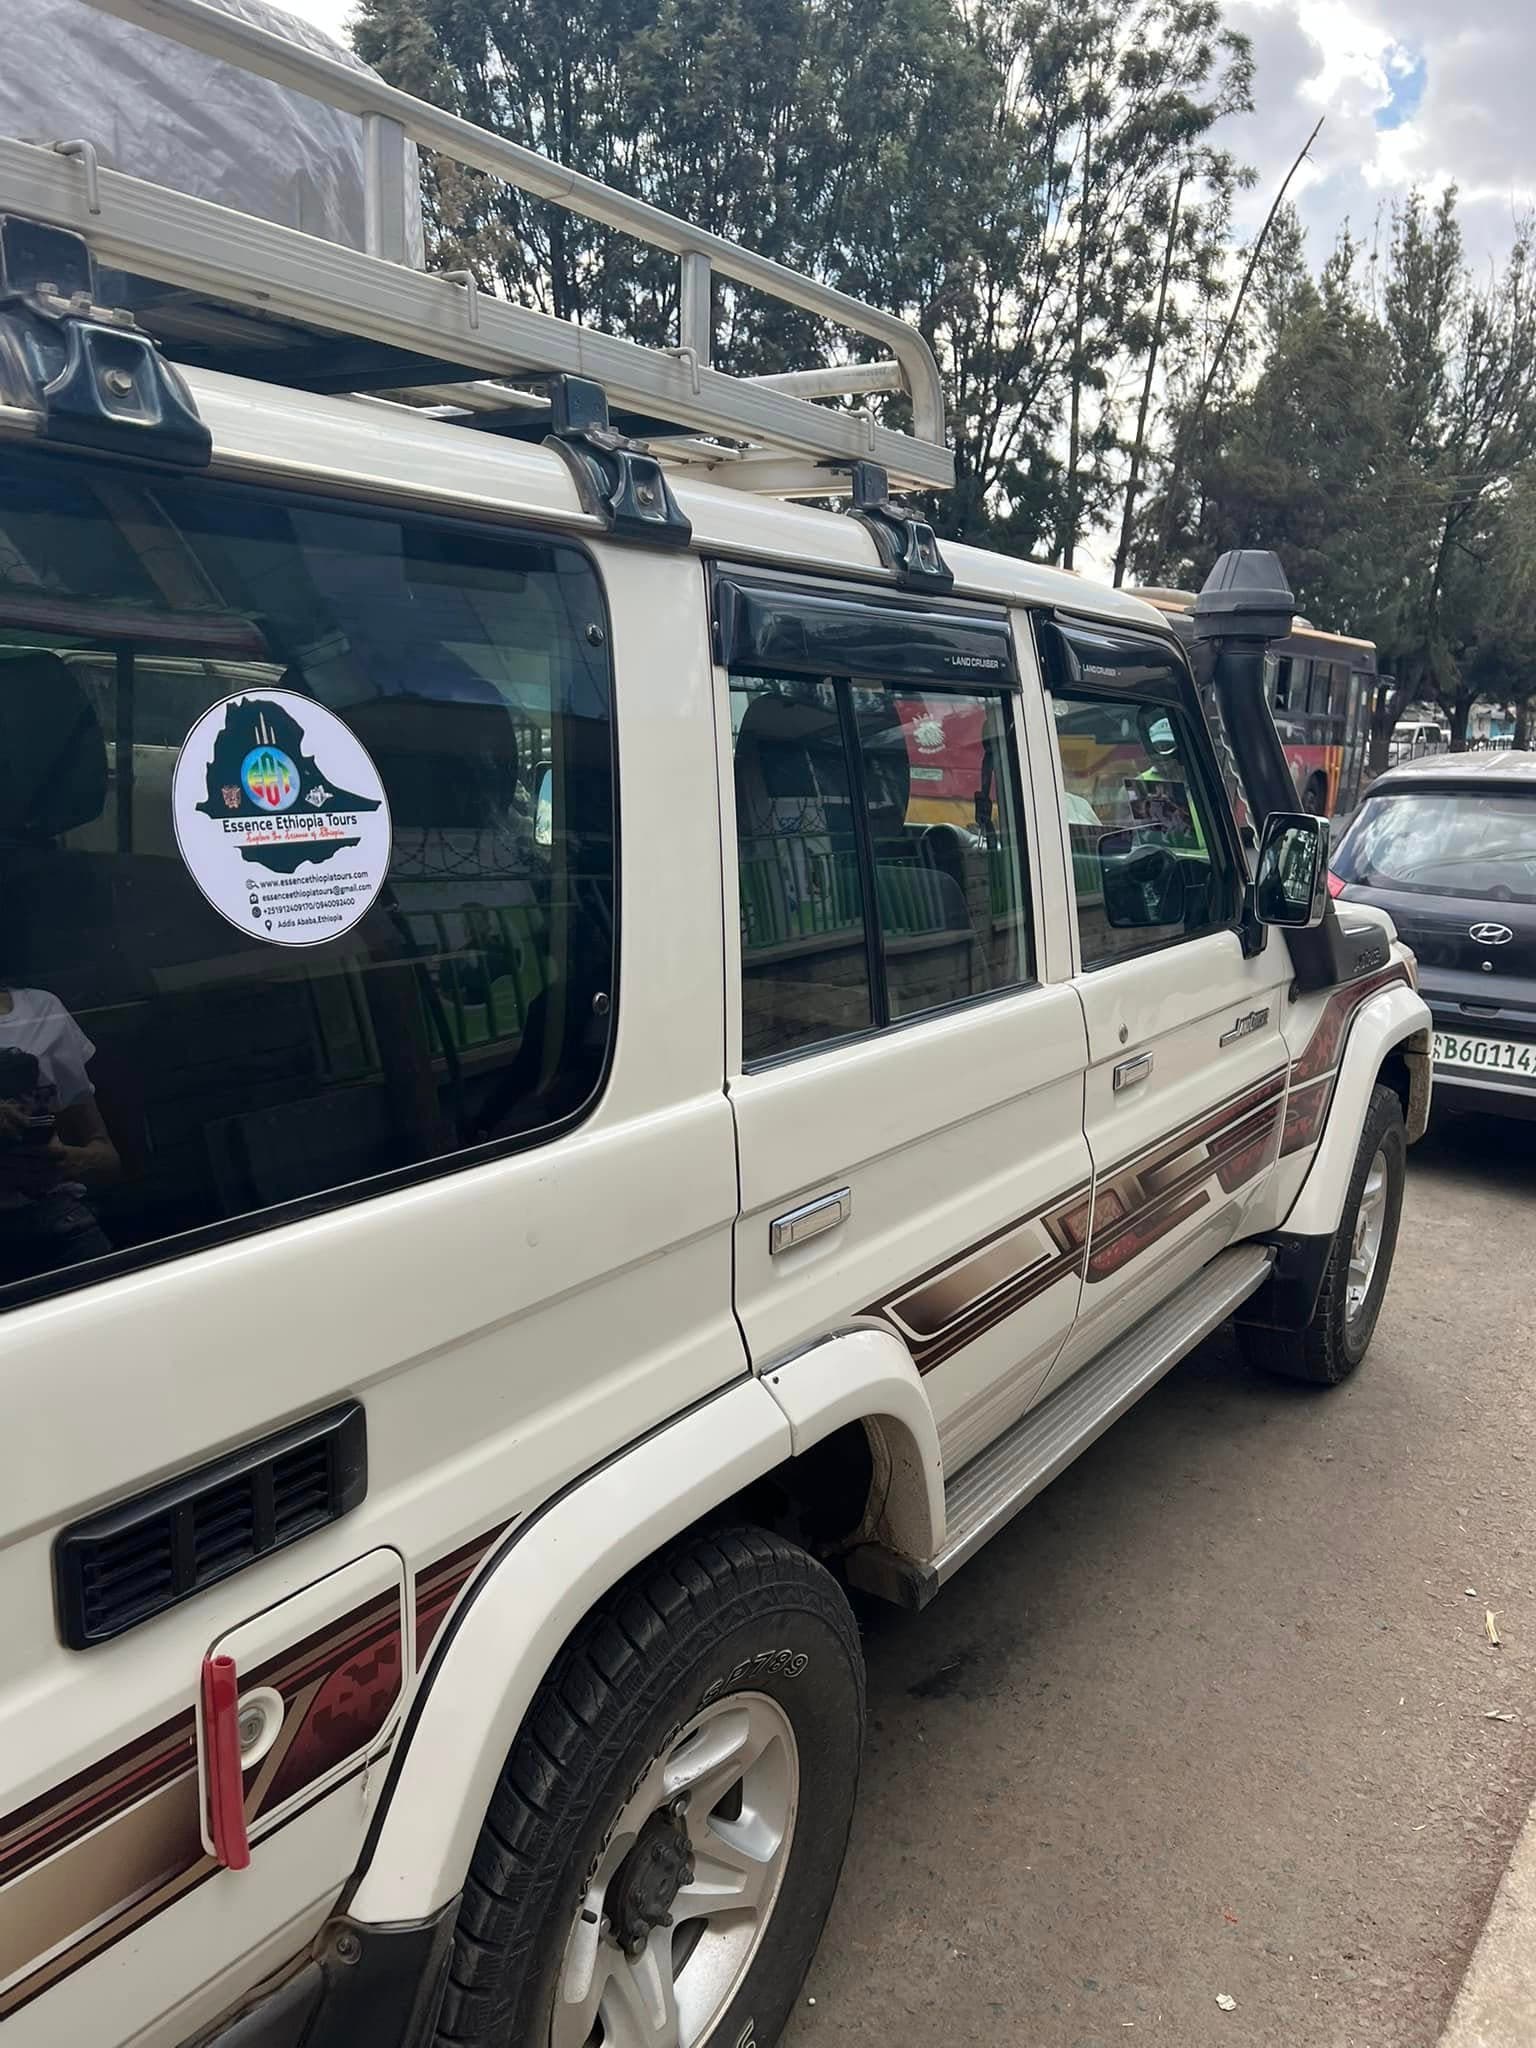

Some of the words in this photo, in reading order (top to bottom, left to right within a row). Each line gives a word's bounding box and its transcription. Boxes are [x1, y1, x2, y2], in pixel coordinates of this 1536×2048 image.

[951, 656, 971, 668] LAND
[971, 658, 999, 670] CRUISER
[222, 819, 273, 833] Essence
[276, 814, 324, 831] Ethiopia
[326, 813, 358, 827] Tours
[277, 919, 296, 929] Addis
